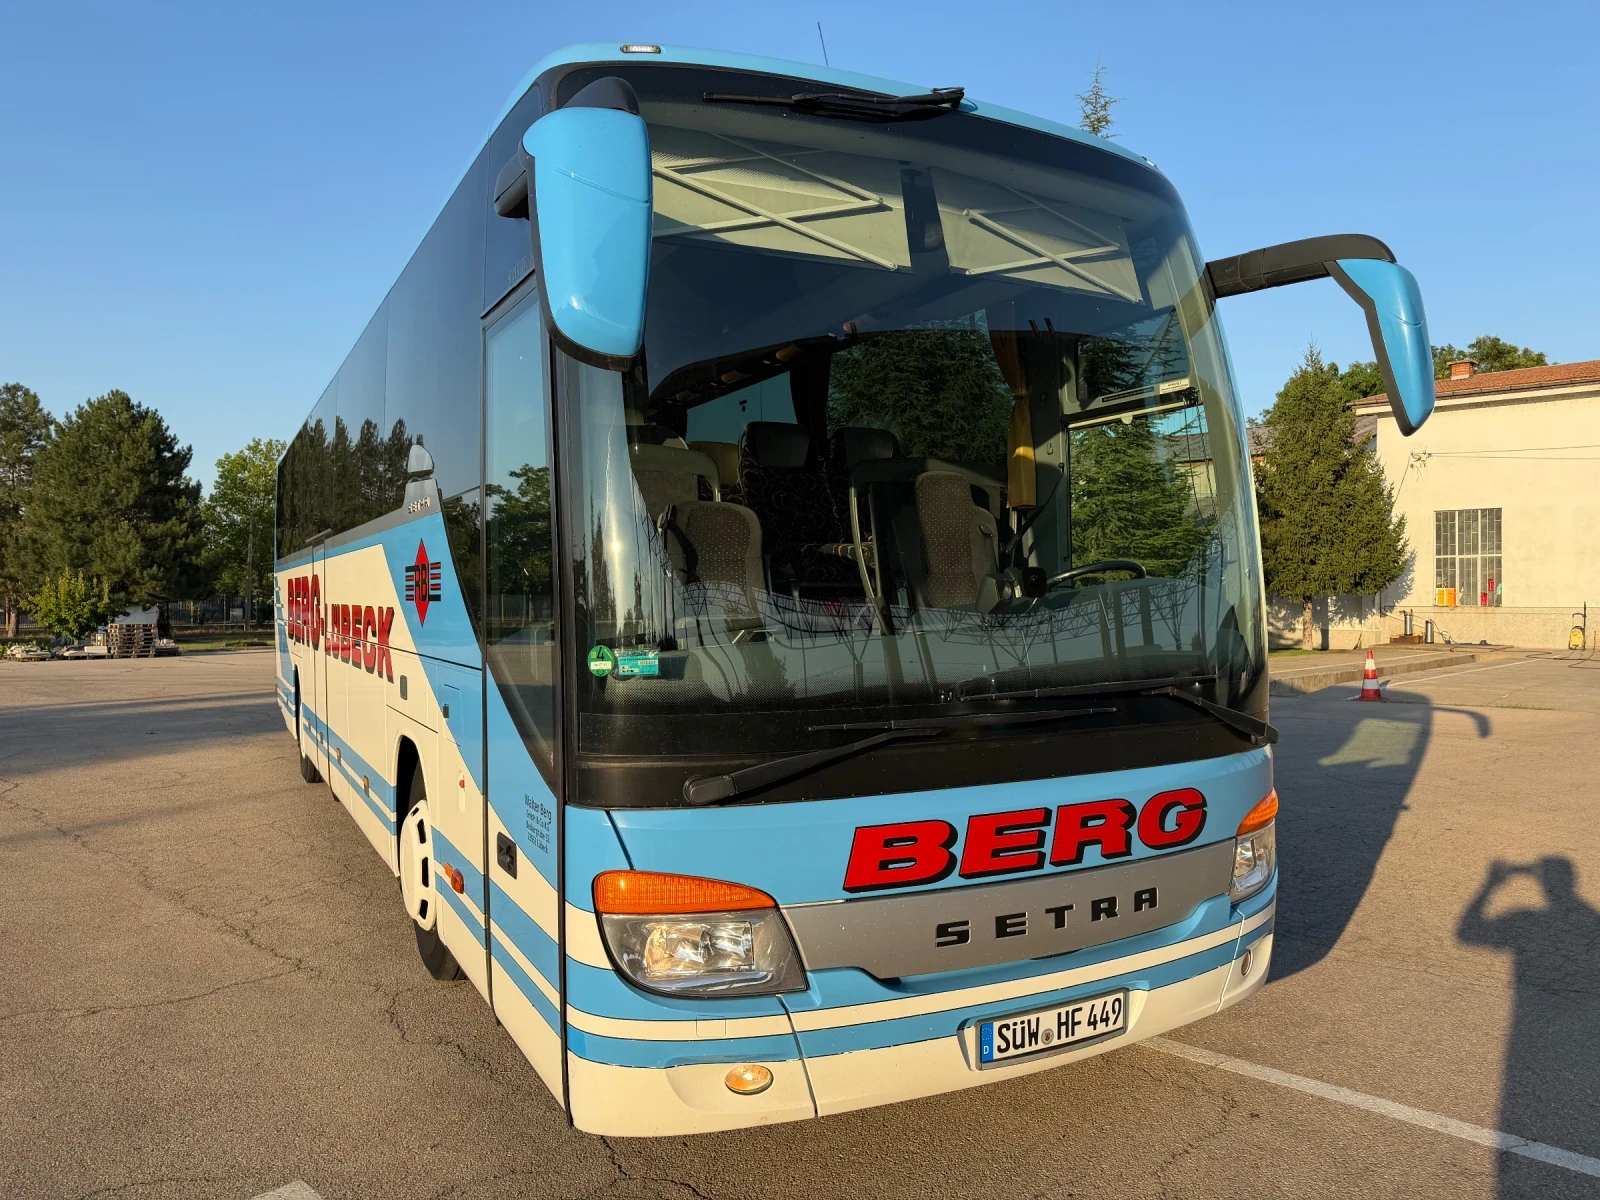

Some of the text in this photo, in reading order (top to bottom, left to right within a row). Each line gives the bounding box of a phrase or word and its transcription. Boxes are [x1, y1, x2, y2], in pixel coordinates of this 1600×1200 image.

[596, 647, 605, 661] 4
[842, 787, 1207, 893] BERG
[935, 887, 1159, 948] SETRA
[983, 1045, 990, 1055] D
[997, 997, 1122, 1054] SÜW HF 449
